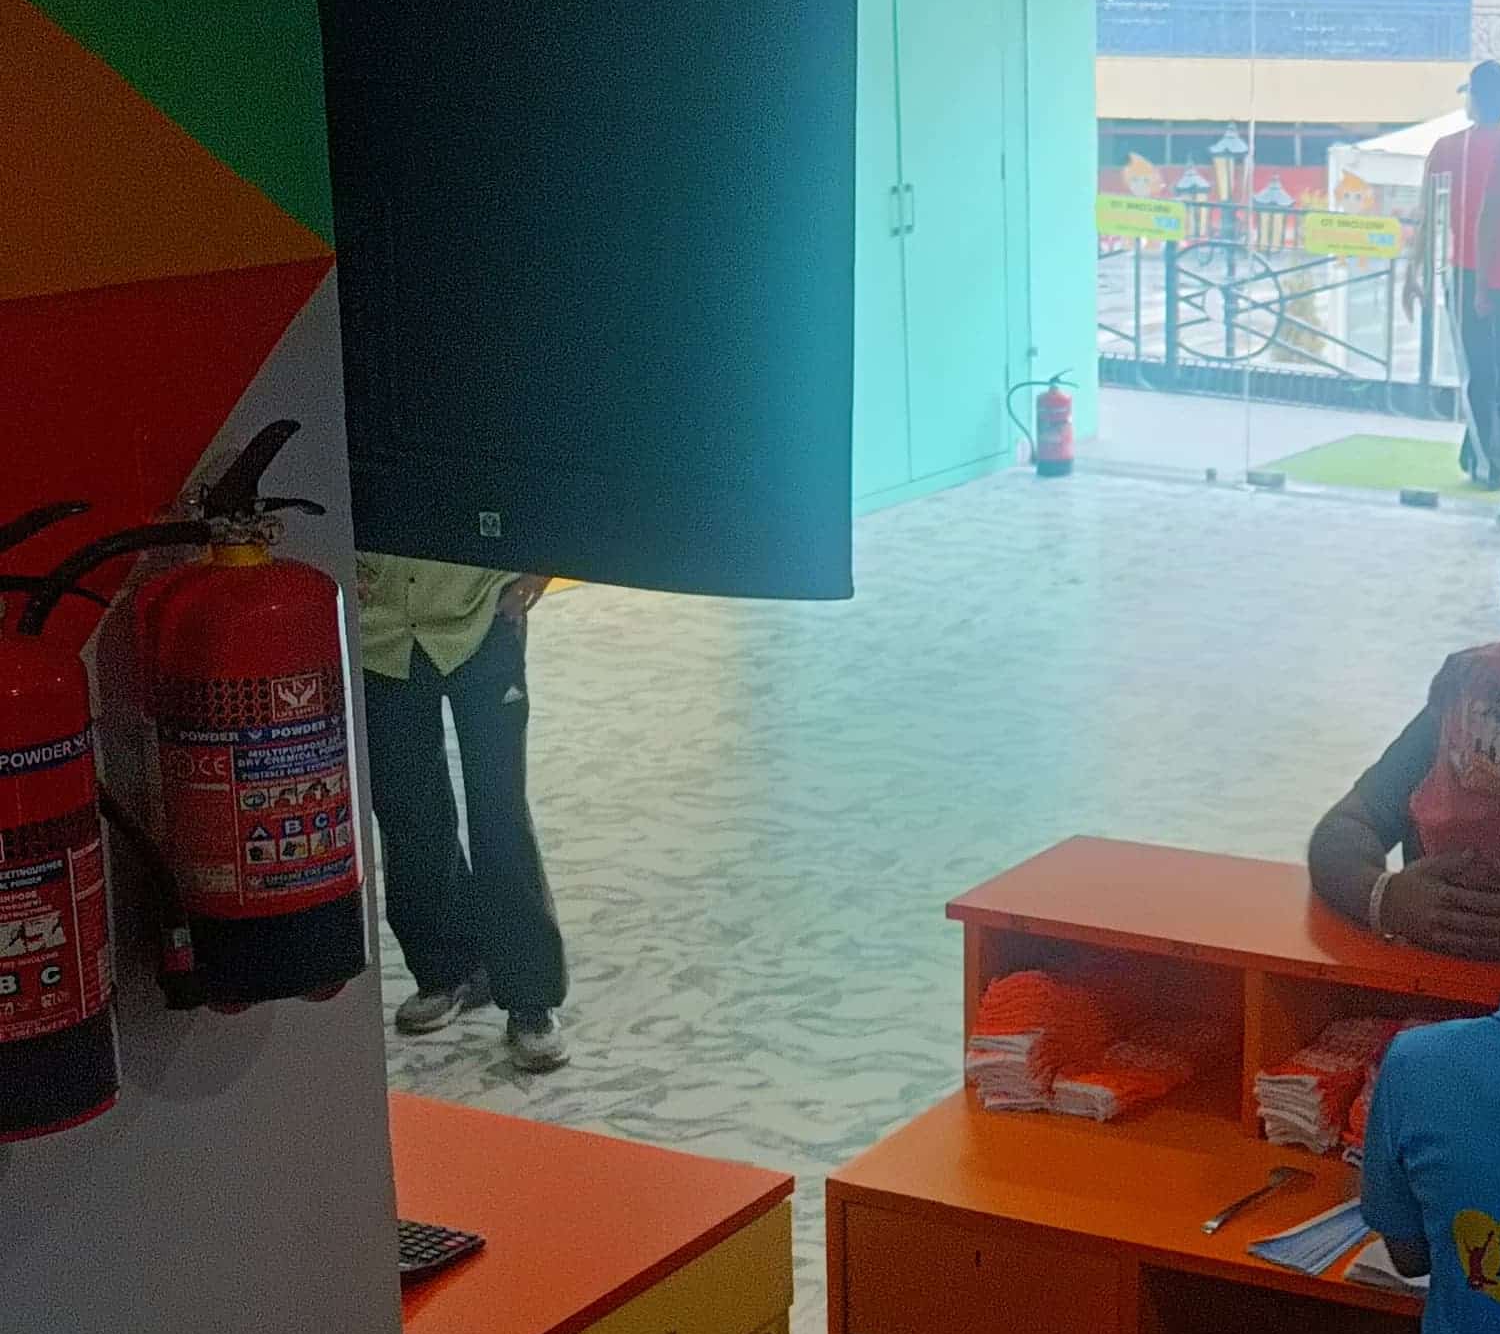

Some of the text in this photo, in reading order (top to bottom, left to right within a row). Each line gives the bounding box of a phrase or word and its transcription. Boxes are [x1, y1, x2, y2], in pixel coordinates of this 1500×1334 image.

[271, 720, 326, 739] POWDER
[0, 740, 72, 771] POWDER
[284, 820, 303, 835] B
[314, 814, 328, 828] C
[40, 965, 62, 985] C
